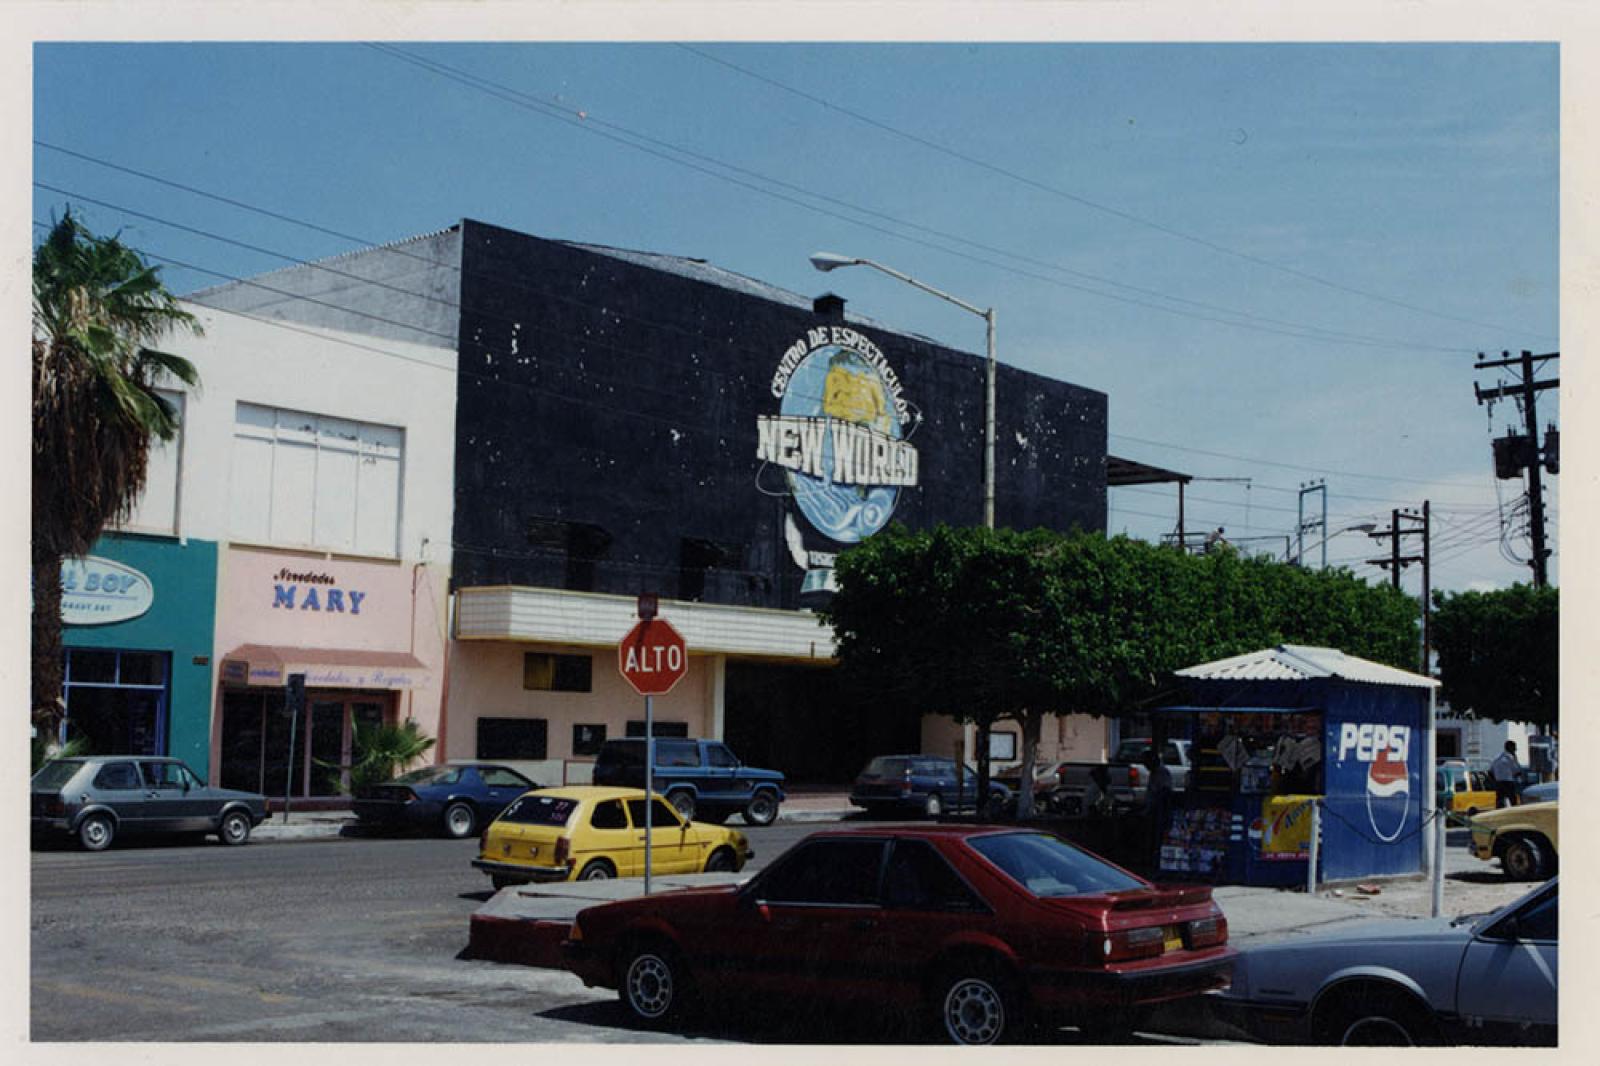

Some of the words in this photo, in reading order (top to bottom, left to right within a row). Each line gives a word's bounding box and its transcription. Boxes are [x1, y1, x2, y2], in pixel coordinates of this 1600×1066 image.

[771, 339, 807, 397] CENTRO
[808, 327, 829, 348] DE
[831, 326, 910, 425] ESPECTACULOS
[757, 415, 824, 476] NEW
[832, 419, 918, 486] WORLD
[85, 571, 136, 594] BOY
[272, 584, 365, 614] MARY
[625, 645, 681, 673] ALTO
[1339, 723, 1410, 762] PEPSI
